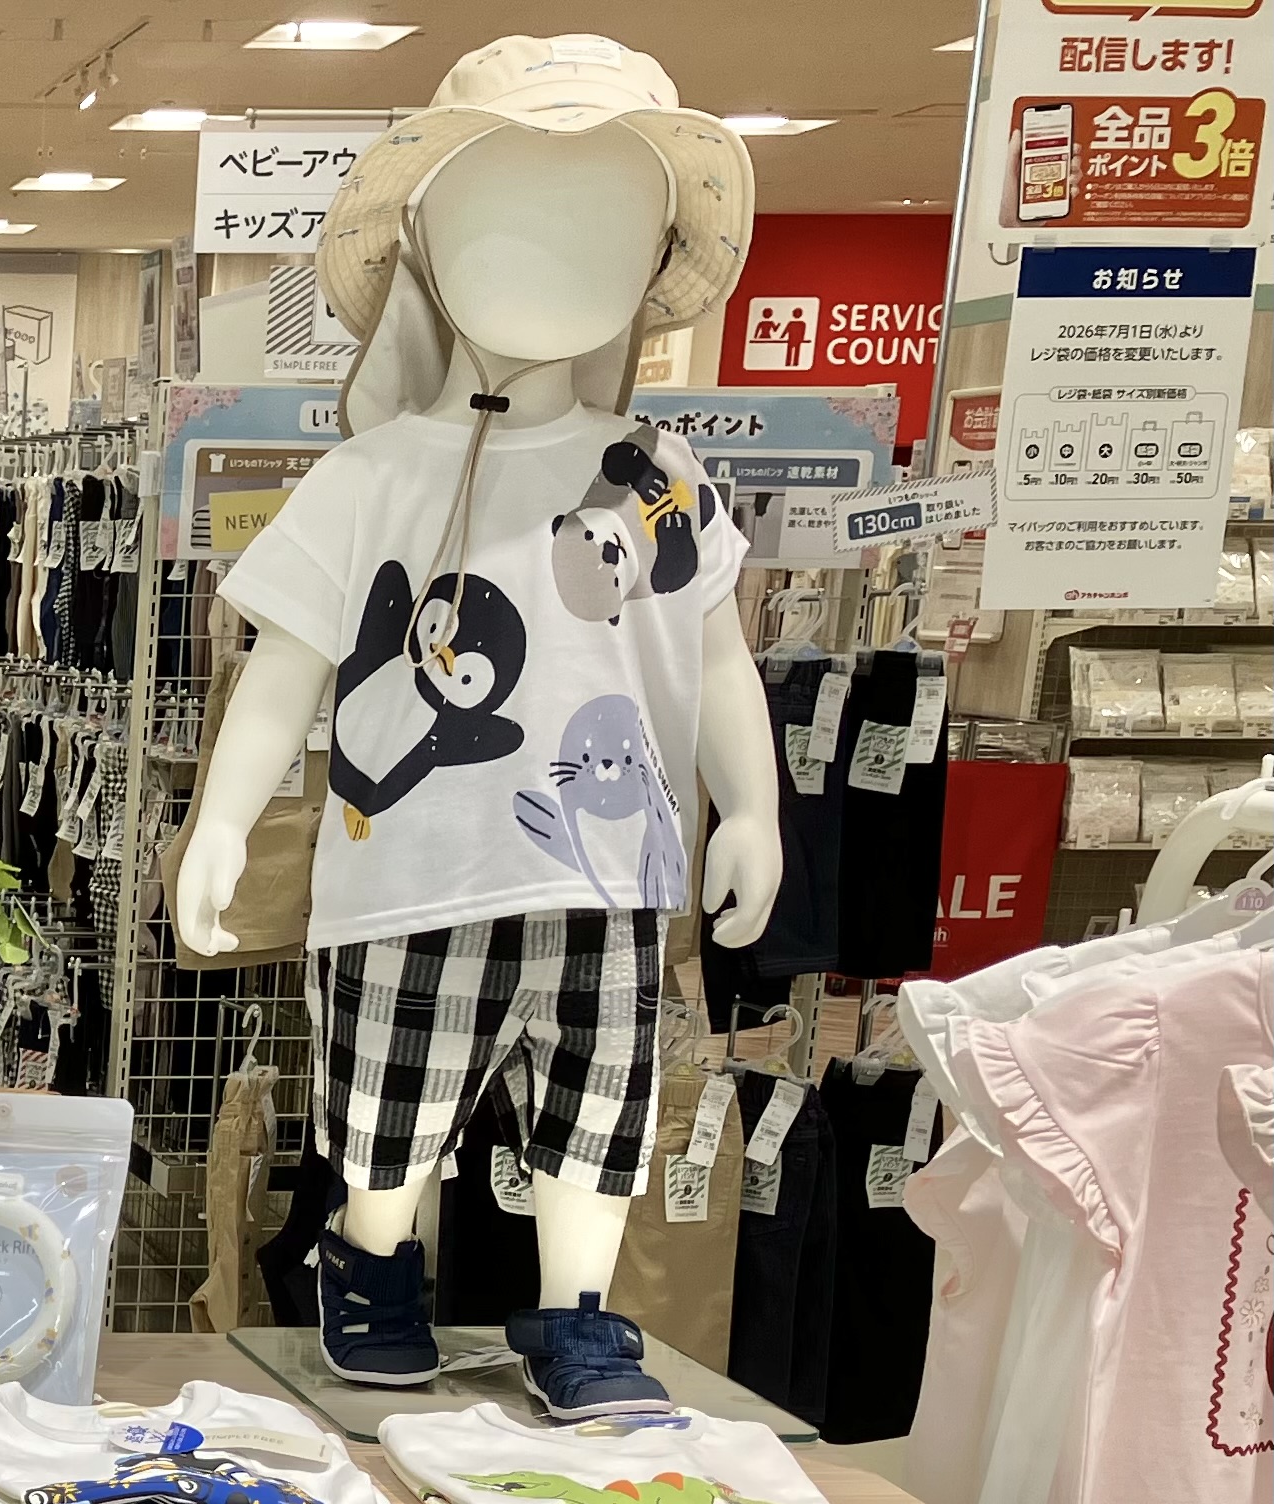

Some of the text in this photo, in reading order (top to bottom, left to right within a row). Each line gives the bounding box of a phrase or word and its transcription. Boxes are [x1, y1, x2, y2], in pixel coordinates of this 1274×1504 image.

[1059, 36, 1234, 74] 配信します!
[1090, 105, 1171, 150] 全品
[1086, 153, 1167, 177] ポイント
[1093, 268, 1183, 290] お知らせ
[1058, 324, 1204, 340] 2026年7月1日(水)より
[1031, 347, 1222, 362] レジ袋の価格を変更いたします。
[313, 361, 338, 371] FREE
[225, 513, 270, 530] NEW
[854, 512, 915, 536] 130cm
[925, 507, 981, 524] はじめました
[937, 875, 1022, 919] LE
[1242, 897, 1263, 909] 110
